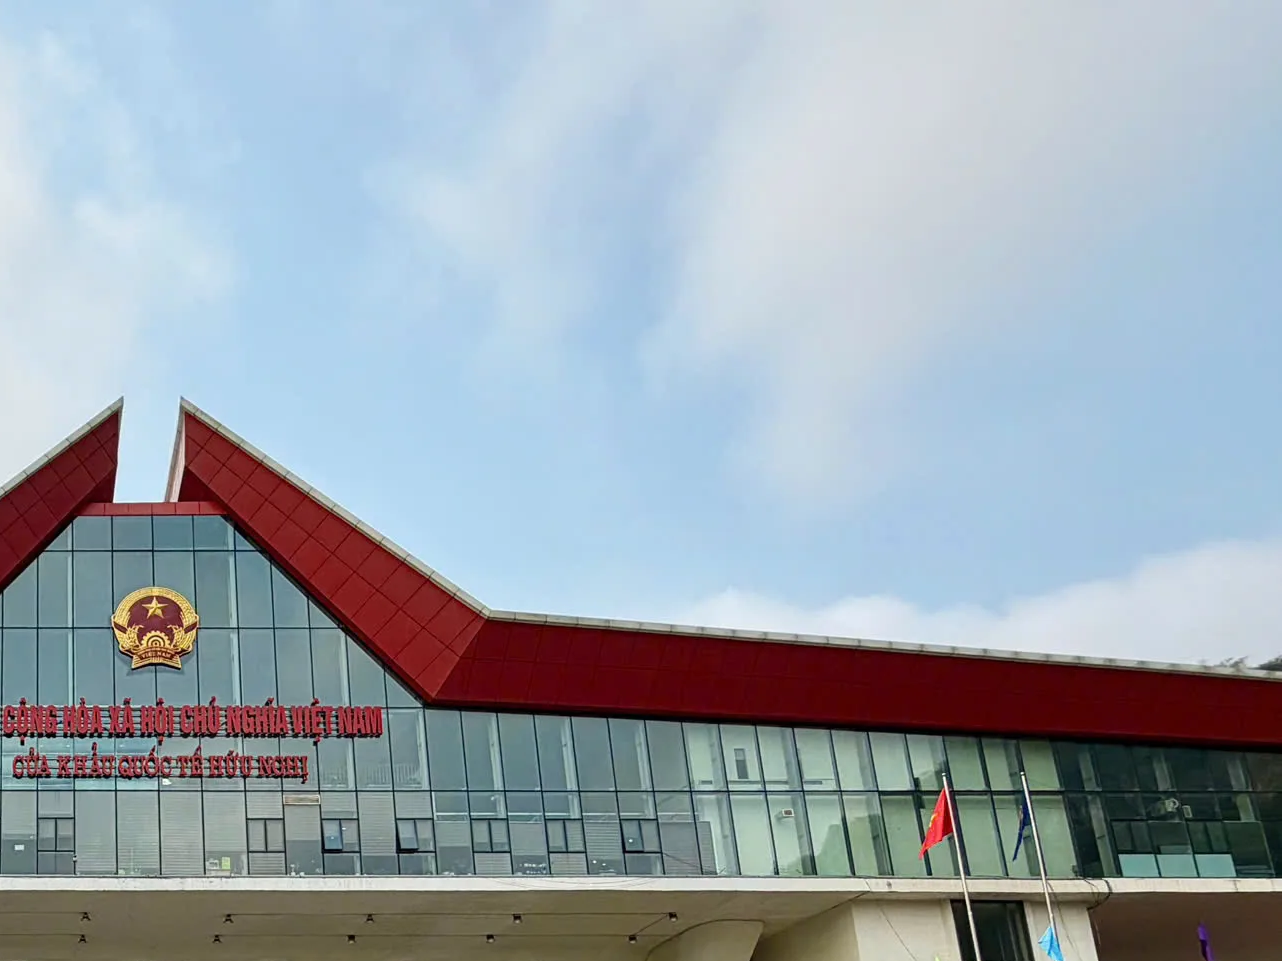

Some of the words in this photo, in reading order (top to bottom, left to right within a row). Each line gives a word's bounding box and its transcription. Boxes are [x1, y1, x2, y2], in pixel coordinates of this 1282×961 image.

[3, 697, 58, 743] CỘNG
[109, 698, 135, 735] XÃ
[140, 698, 175, 743] HỘI
[226, 697, 288, 736] NGHĨA
[291, 698, 333, 743] VIỆT
[336, 706, 384, 737] NAM
[12, 747, 52, 777] CỬA
[57, 742, 116, 777] KHẨU
[118, 745, 173, 778] QUỐC
[177, 745, 204, 777] TẾ
[258, 756, 309, 783] NGHỊ
